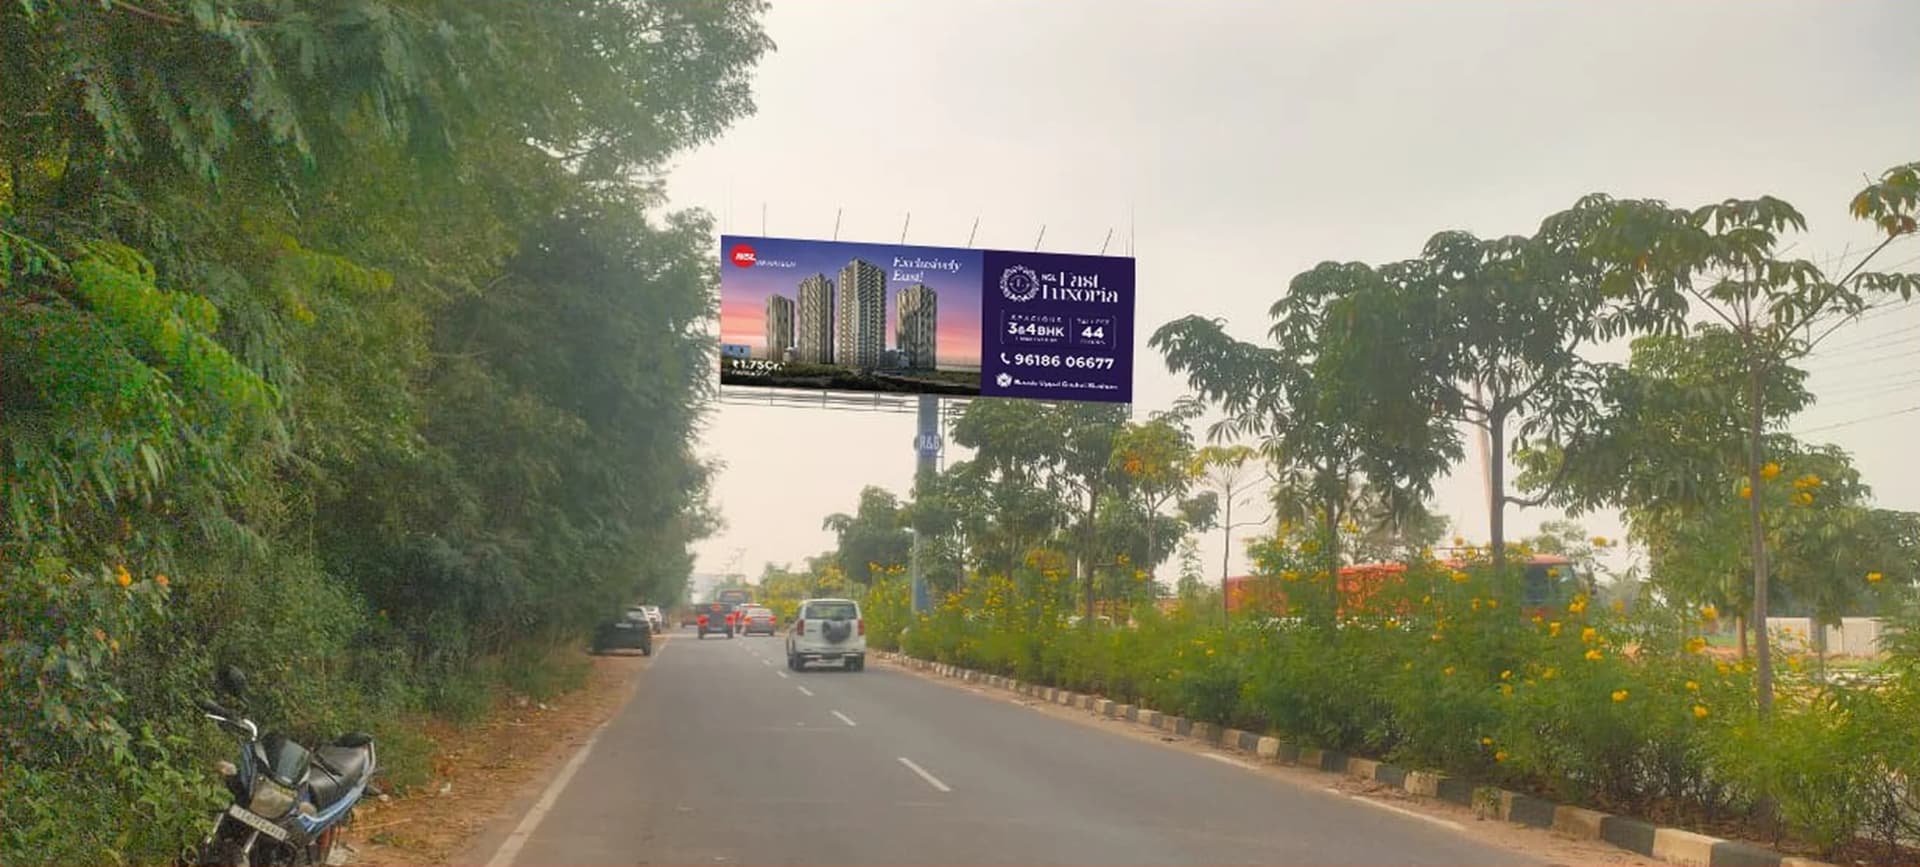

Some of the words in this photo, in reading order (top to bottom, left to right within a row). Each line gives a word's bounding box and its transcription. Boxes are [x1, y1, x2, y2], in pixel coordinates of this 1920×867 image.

[892, 256, 962, 273] Exclusively
[1060, 271, 1098, 289] East
[1042, 284, 1118, 303] Luxoria
[1081, 326, 1105, 339] 44
[1014, 353, 1061, 368] 96186
[1065, 356, 1114, 370] 06677
